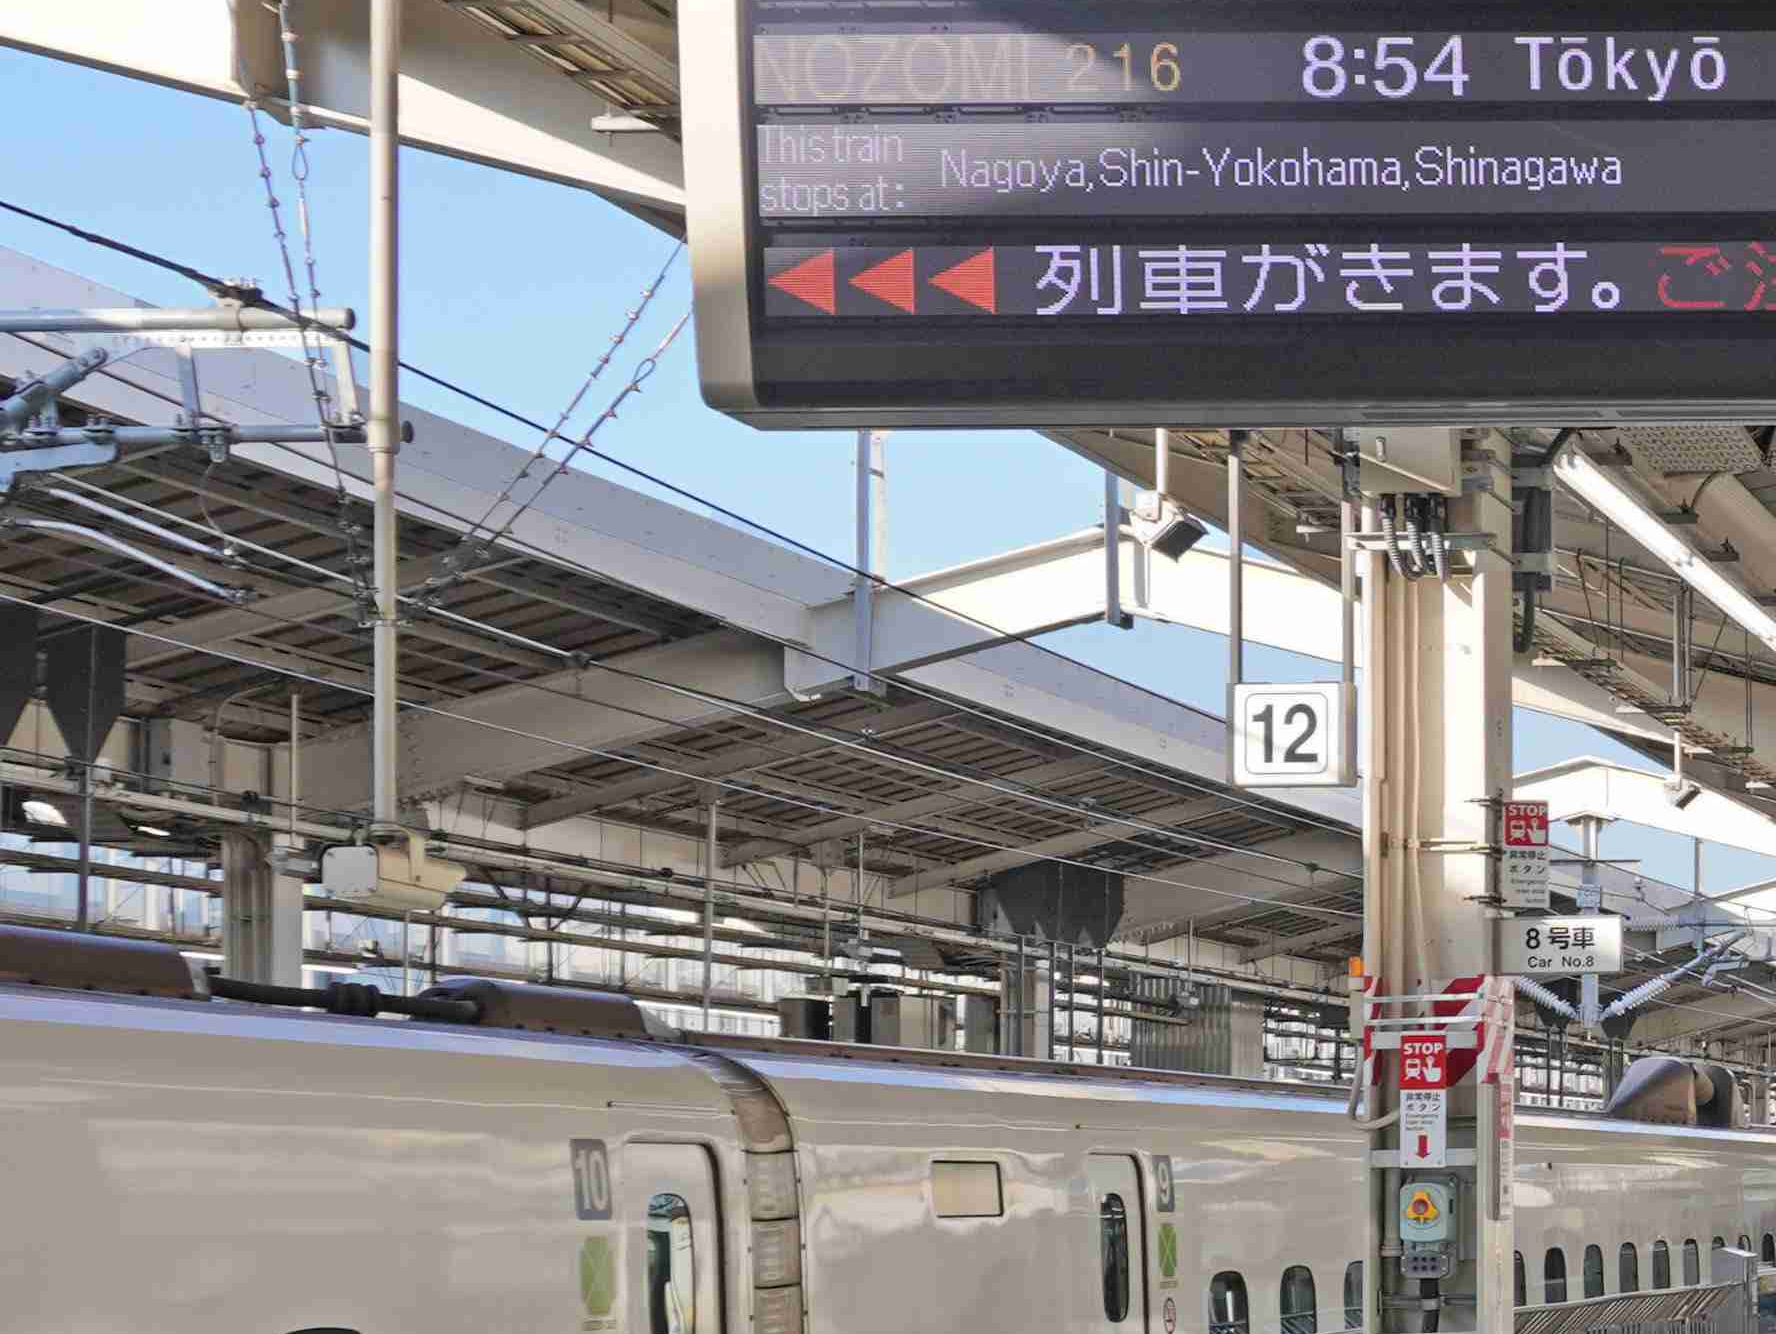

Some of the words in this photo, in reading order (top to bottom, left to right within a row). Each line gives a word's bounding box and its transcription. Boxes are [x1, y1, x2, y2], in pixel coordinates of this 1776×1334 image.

[754, 37, 1033, 103] NOZOMI
[1066, 42, 1181, 92] 216
[1303, 34, 1469, 97] 8:54
[1515, 36, 1726, 102] Tōkyō
[757, 127, 828, 165] This
[830, 128, 904, 164] train
[760, 177, 845, 214] stops
[1252, 704, 1318, 764] 12
[1508, 805, 1548, 817] STOP
[1526, 927, 1594, 950] 8号車
[1527, 955, 1552, 969] Car
[1562, 955, 1594, 968] No.8
[1403, 1042, 1443, 1055] STOP
[576, 1150, 609, 1211] 10
[1158, 1165, 1170, 1204] 9
